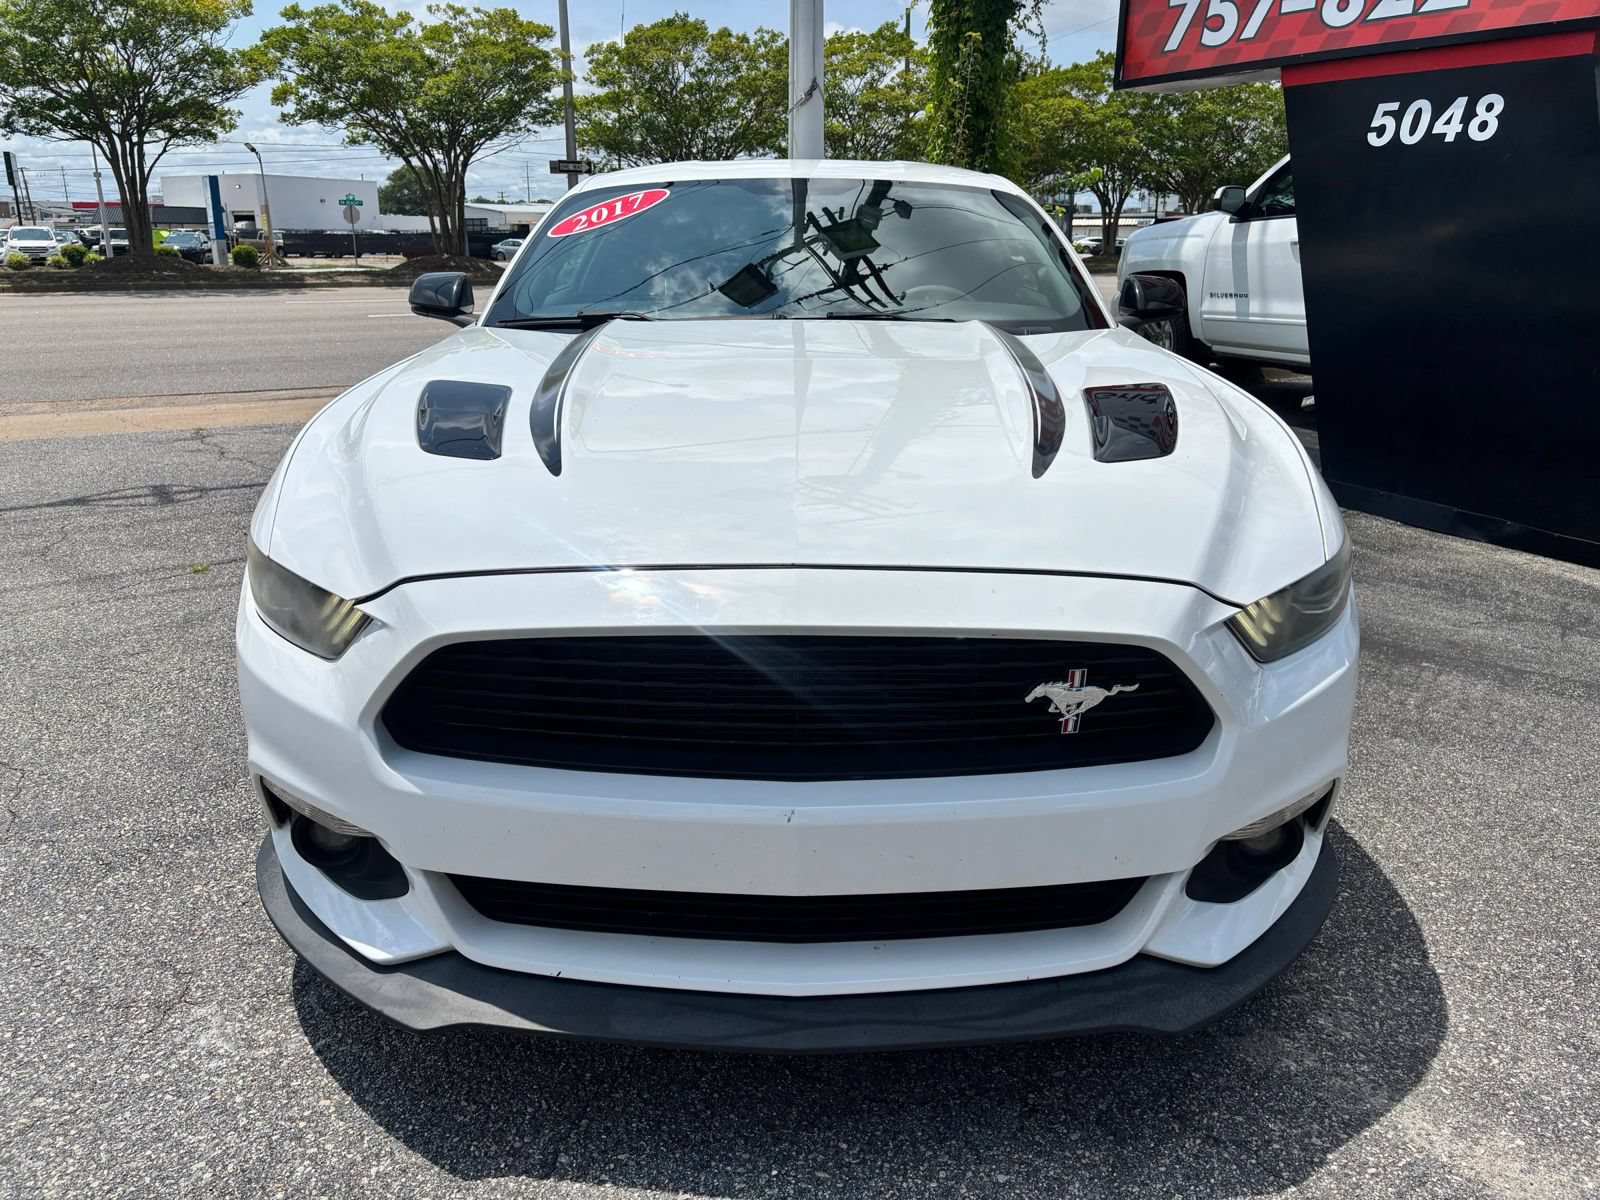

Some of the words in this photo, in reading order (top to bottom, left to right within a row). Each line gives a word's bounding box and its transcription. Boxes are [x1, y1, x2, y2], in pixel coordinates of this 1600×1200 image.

[1162, 0, 1470, 50] 757-
[1367, 94, 1505, 147] 5048
[572, 192, 645, 233] 2017
[1209, 291, 1249, 299] SILVERADO
